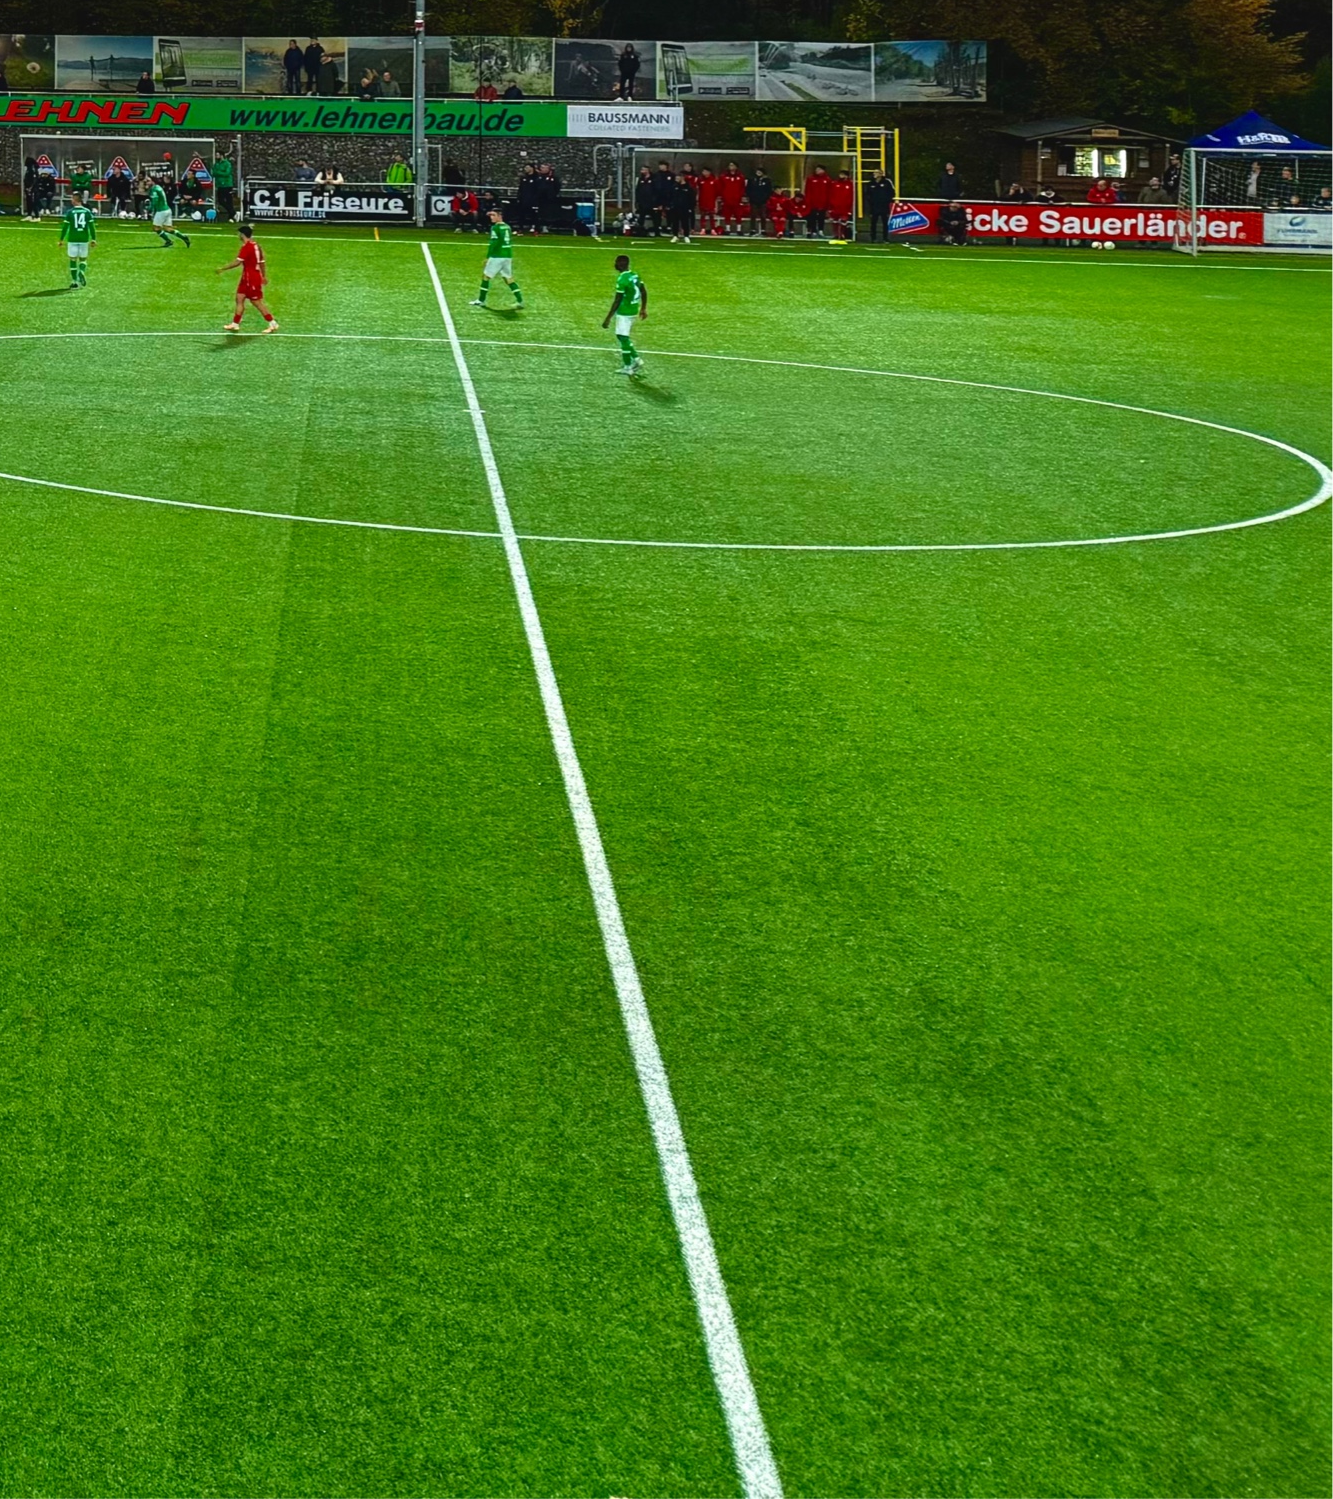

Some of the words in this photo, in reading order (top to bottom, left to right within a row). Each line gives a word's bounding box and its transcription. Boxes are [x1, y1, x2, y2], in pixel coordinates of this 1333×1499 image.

[587, 112, 670, 125] BAUSSMANN
[253, 190, 286, 208] C1
[297, 191, 404, 211] Friseure
[73, 213, 87, 229] 14
[965, 208, 1029, 232] icke
